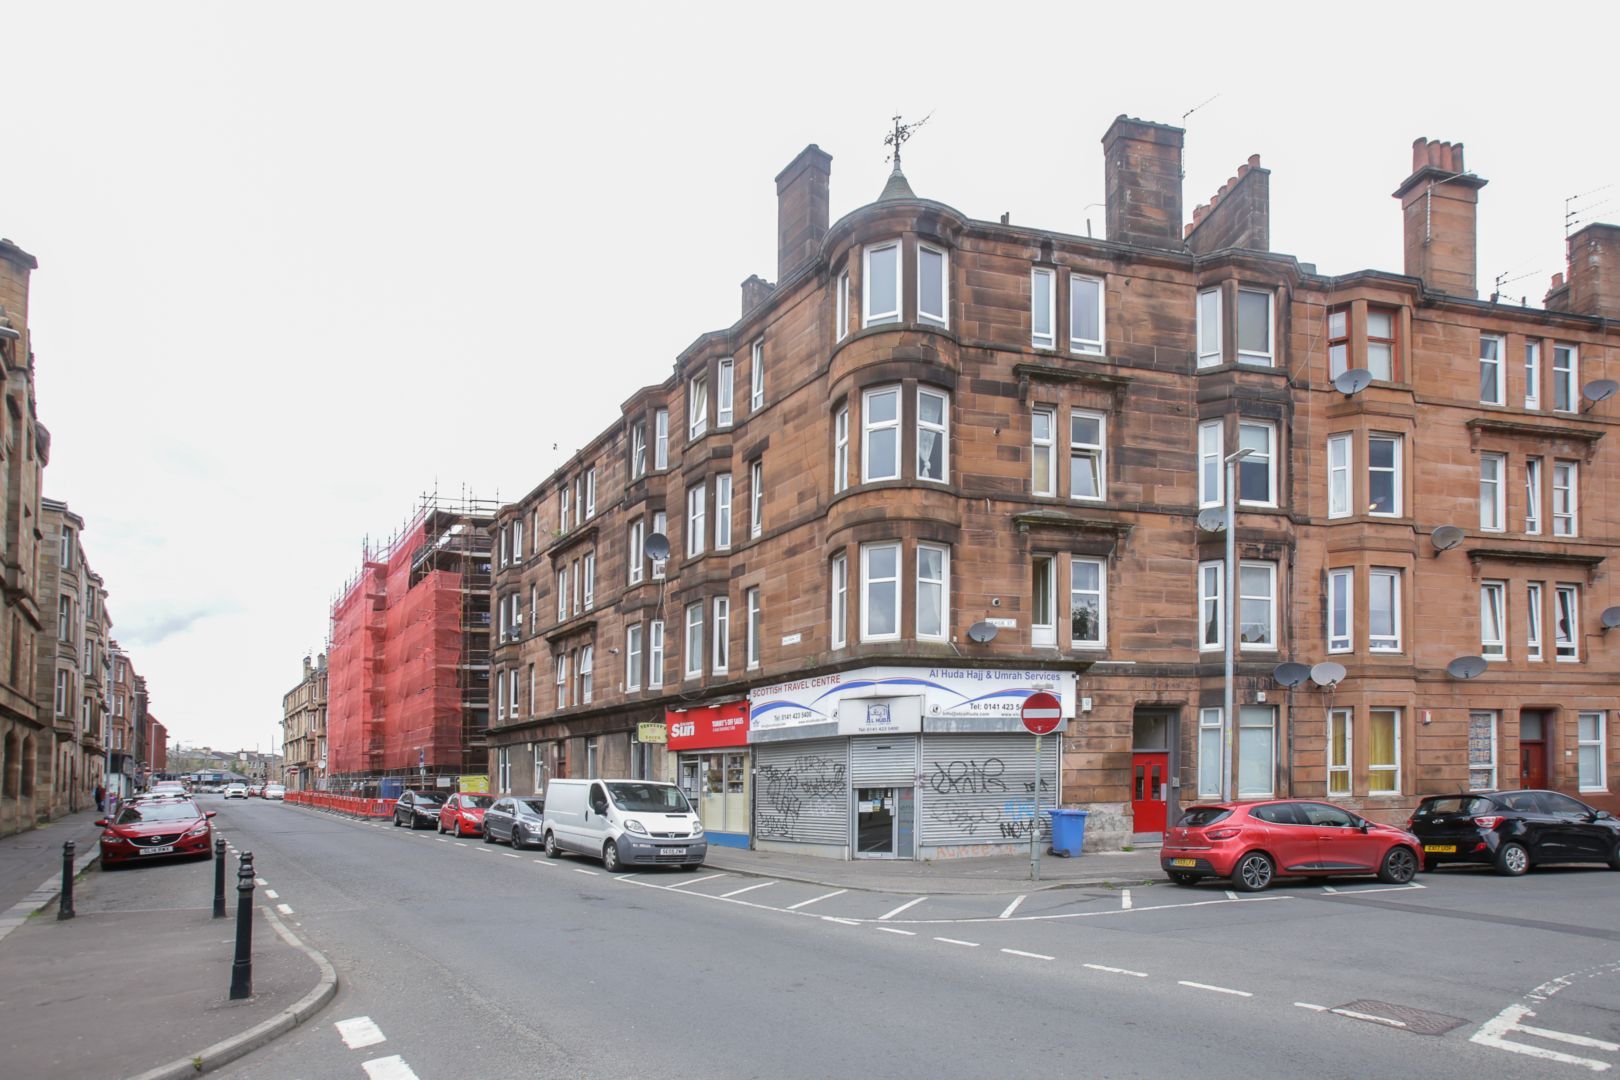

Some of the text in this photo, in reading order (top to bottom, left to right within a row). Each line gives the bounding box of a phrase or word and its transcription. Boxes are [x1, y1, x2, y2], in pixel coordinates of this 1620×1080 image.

[929, 669, 1061, 681] Al Huda Hajj & Umrah Services
[752, 674, 841, 698] SCOTTISH TRAVEL CENTRE
[1002, 703, 1014, 711] 423
[671, 723, 695, 738] Sun
